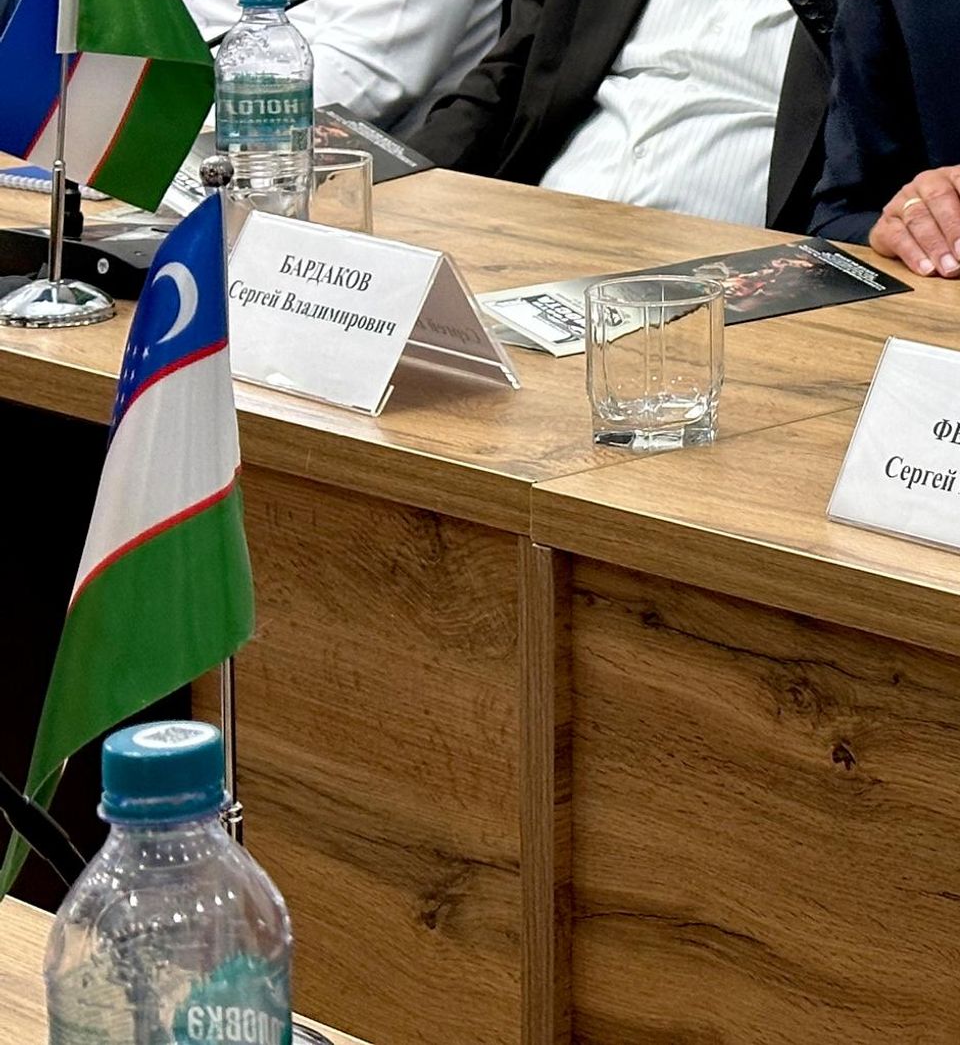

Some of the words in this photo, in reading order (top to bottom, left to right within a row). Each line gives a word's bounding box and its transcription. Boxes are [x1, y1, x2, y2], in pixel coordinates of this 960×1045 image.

[279, 254, 373, 293] БАРДАКОВ
[228, 280, 281, 312] Сергей
[280, 295, 397, 336] Владимирович
[884, 456, 958, 491] Сергей
